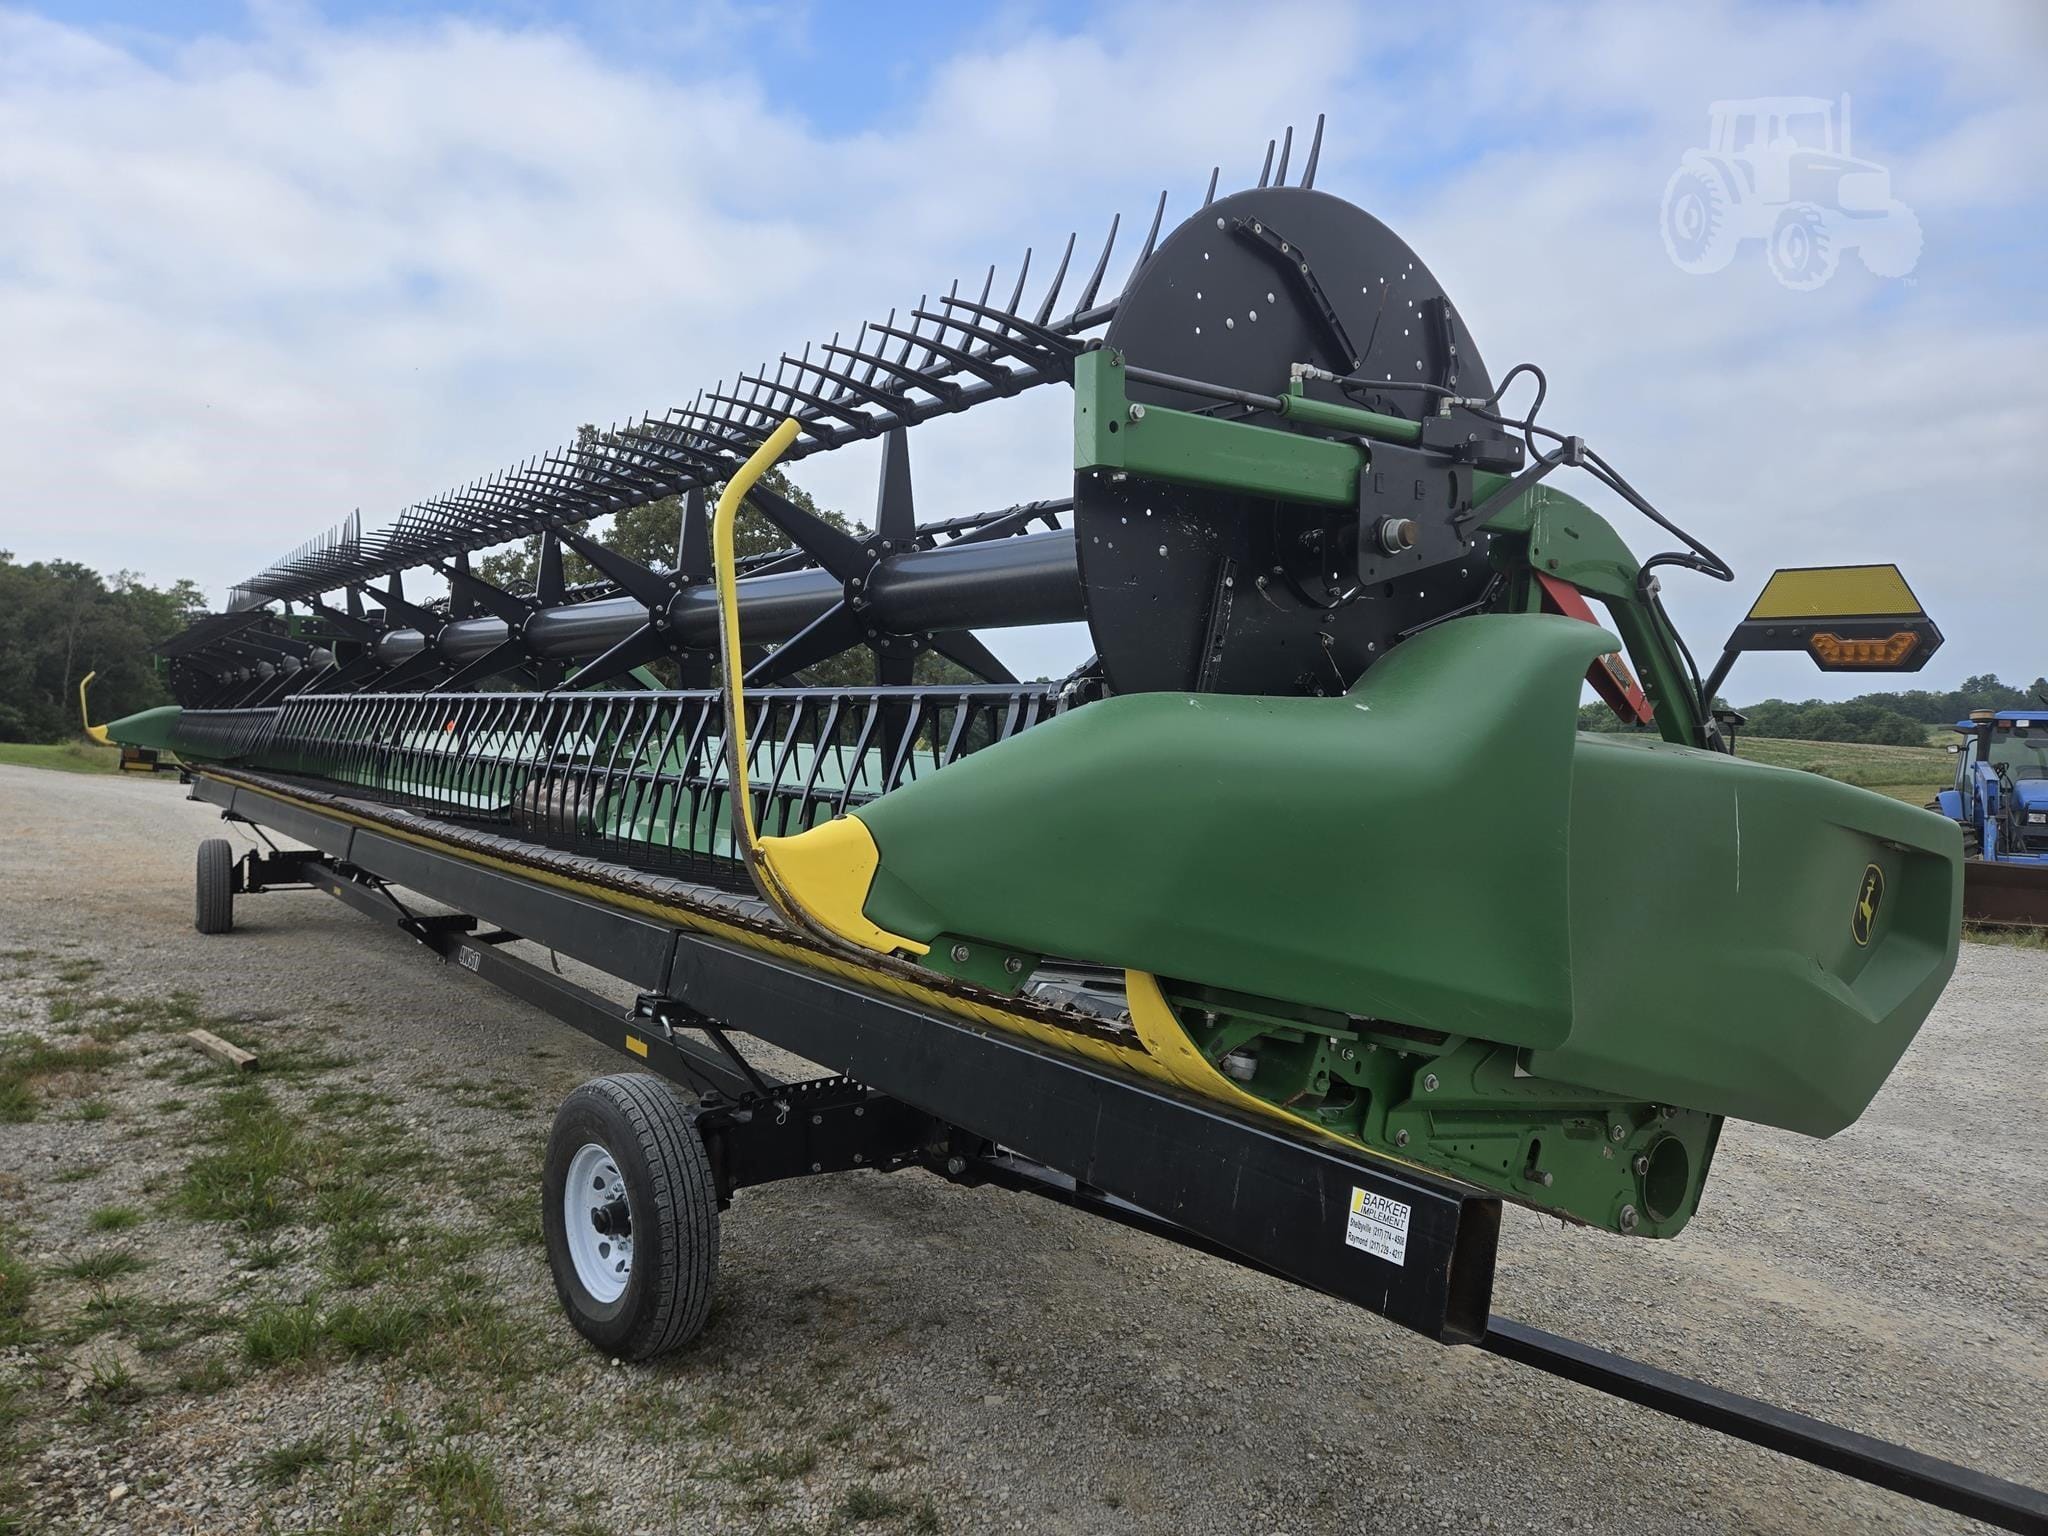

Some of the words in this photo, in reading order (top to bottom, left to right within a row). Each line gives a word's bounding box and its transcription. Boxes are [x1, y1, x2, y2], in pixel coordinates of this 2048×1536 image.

[1363, 1193, 1408, 1220] BARKER
[1349, 1217, 1372, 1233] Shelbyville
[1360, 1205, 1405, 1228] IMPLEMENT
[1348, 1231, 1368, 1247] Raymond
